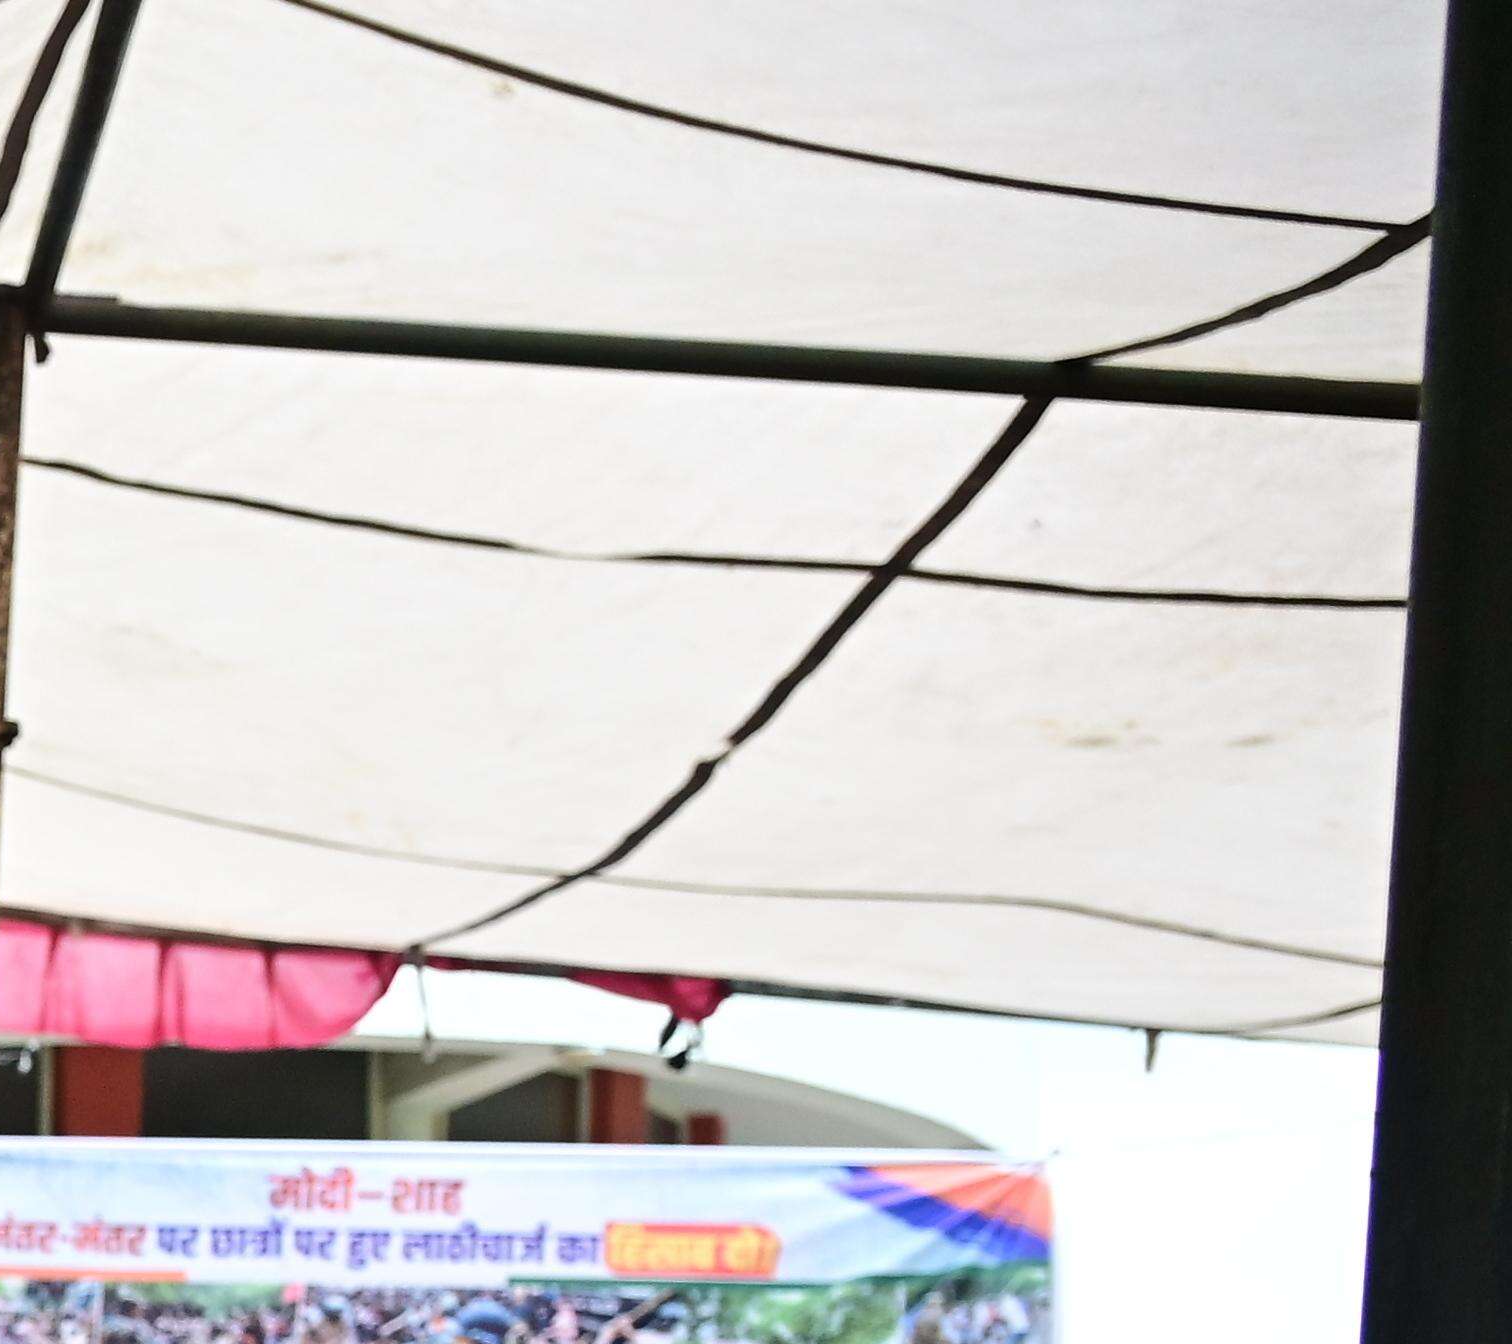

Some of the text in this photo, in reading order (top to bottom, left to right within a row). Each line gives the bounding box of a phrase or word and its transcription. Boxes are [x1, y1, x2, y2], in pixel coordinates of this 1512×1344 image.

[157, 1223, 199, 1258] पर
[295, 1225, 338, 1260] पर
[557, 1232, 601, 1264] का
